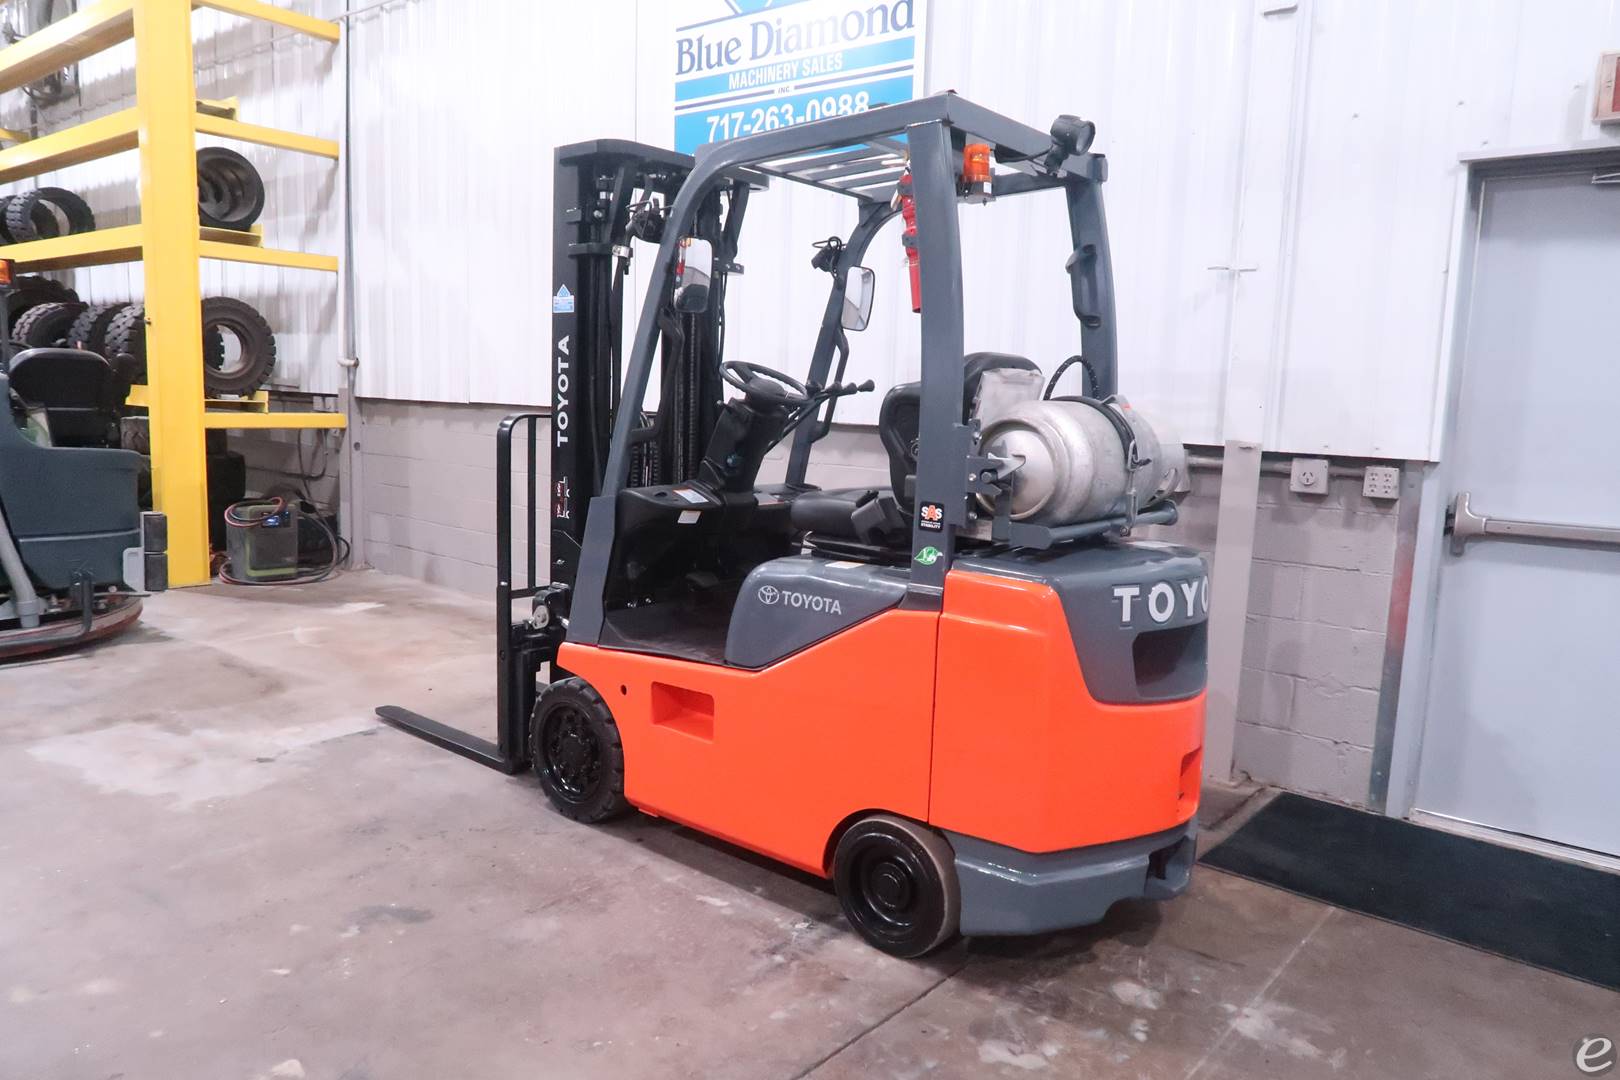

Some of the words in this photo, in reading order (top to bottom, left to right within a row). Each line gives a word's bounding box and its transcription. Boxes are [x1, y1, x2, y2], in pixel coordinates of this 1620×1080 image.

[676, 33, 742, 76] Blue
[749, 0, 915, 61] Diamond
[728, 61, 800, 91] MACHINERY
[802, 52, 844, 77] SALES
[706, 91, 870, 144] 717-263-0988
[557, 335, 570, 447] TOYOTA
[920, 504, 943, 520] SAS
[781, 590, 842, 615] TOYOTA
[1113, 575, 1209, 623] TOYO
